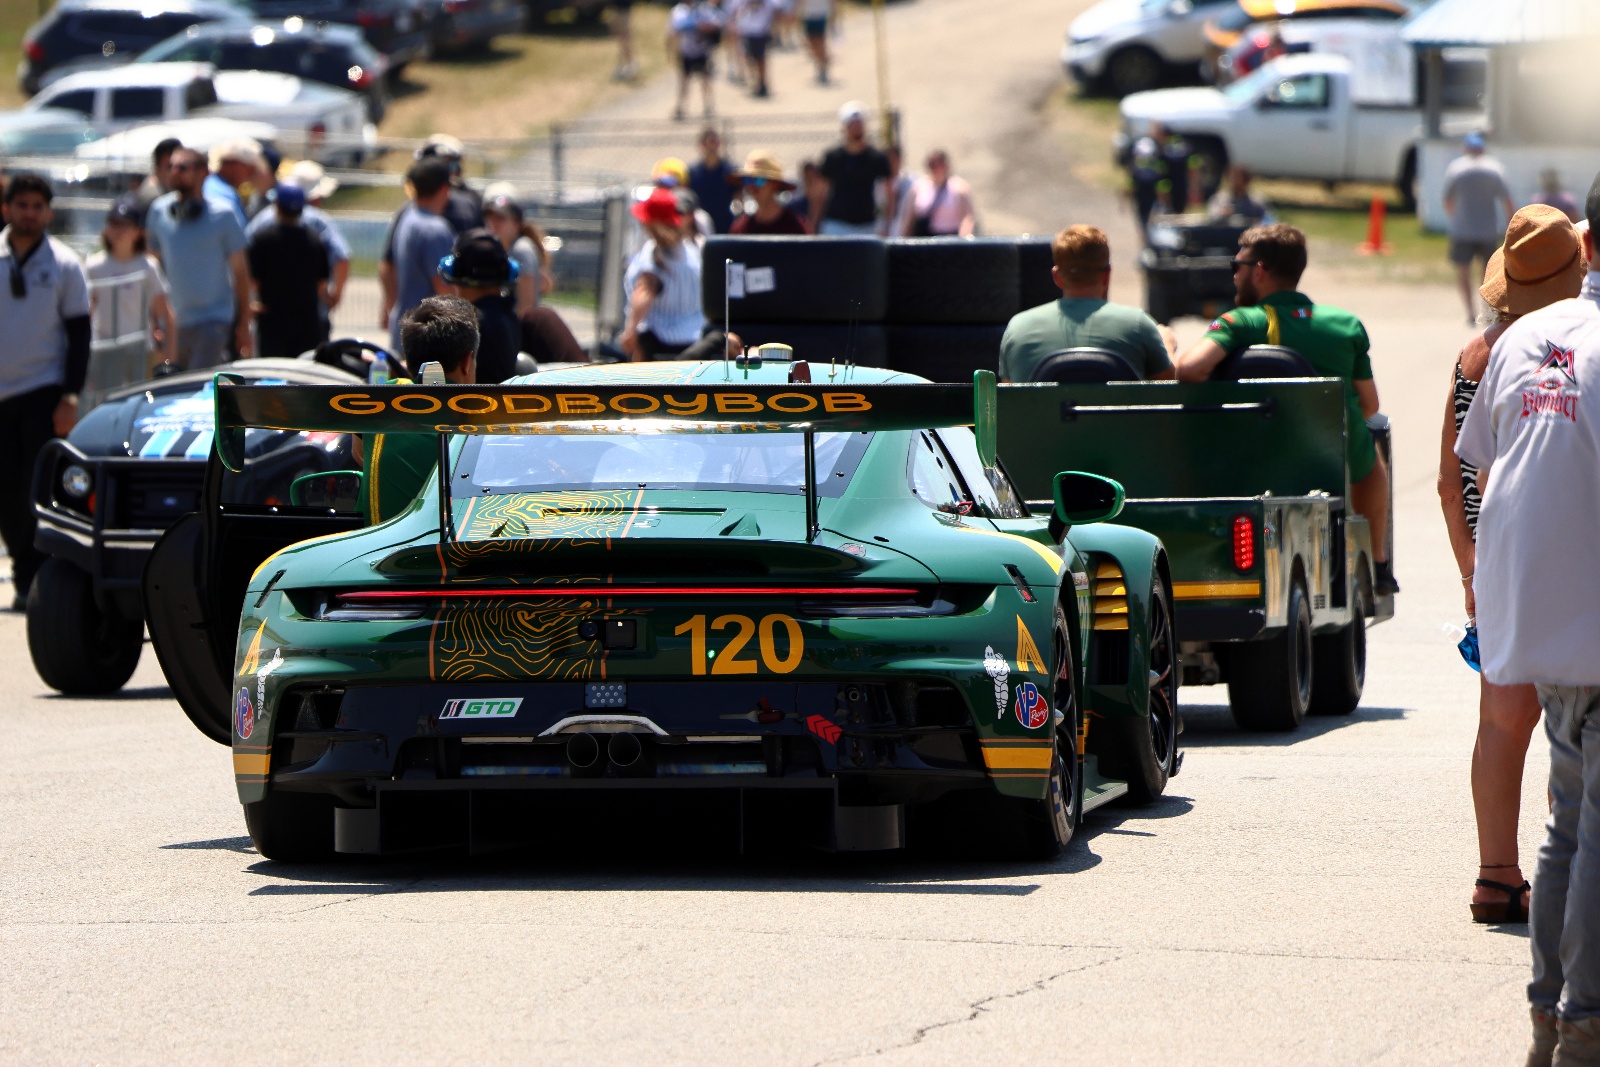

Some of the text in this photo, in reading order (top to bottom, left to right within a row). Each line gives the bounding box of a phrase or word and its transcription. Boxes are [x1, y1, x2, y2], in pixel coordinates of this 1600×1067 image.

[591, 423, 782, 434] ROSTERS
[674, 613, 804, 676] 120
[465, 701, 516, 715] GTD
[1015, 681, 1039, 728] VP
[1030, 708, 1048, 723] Racing
